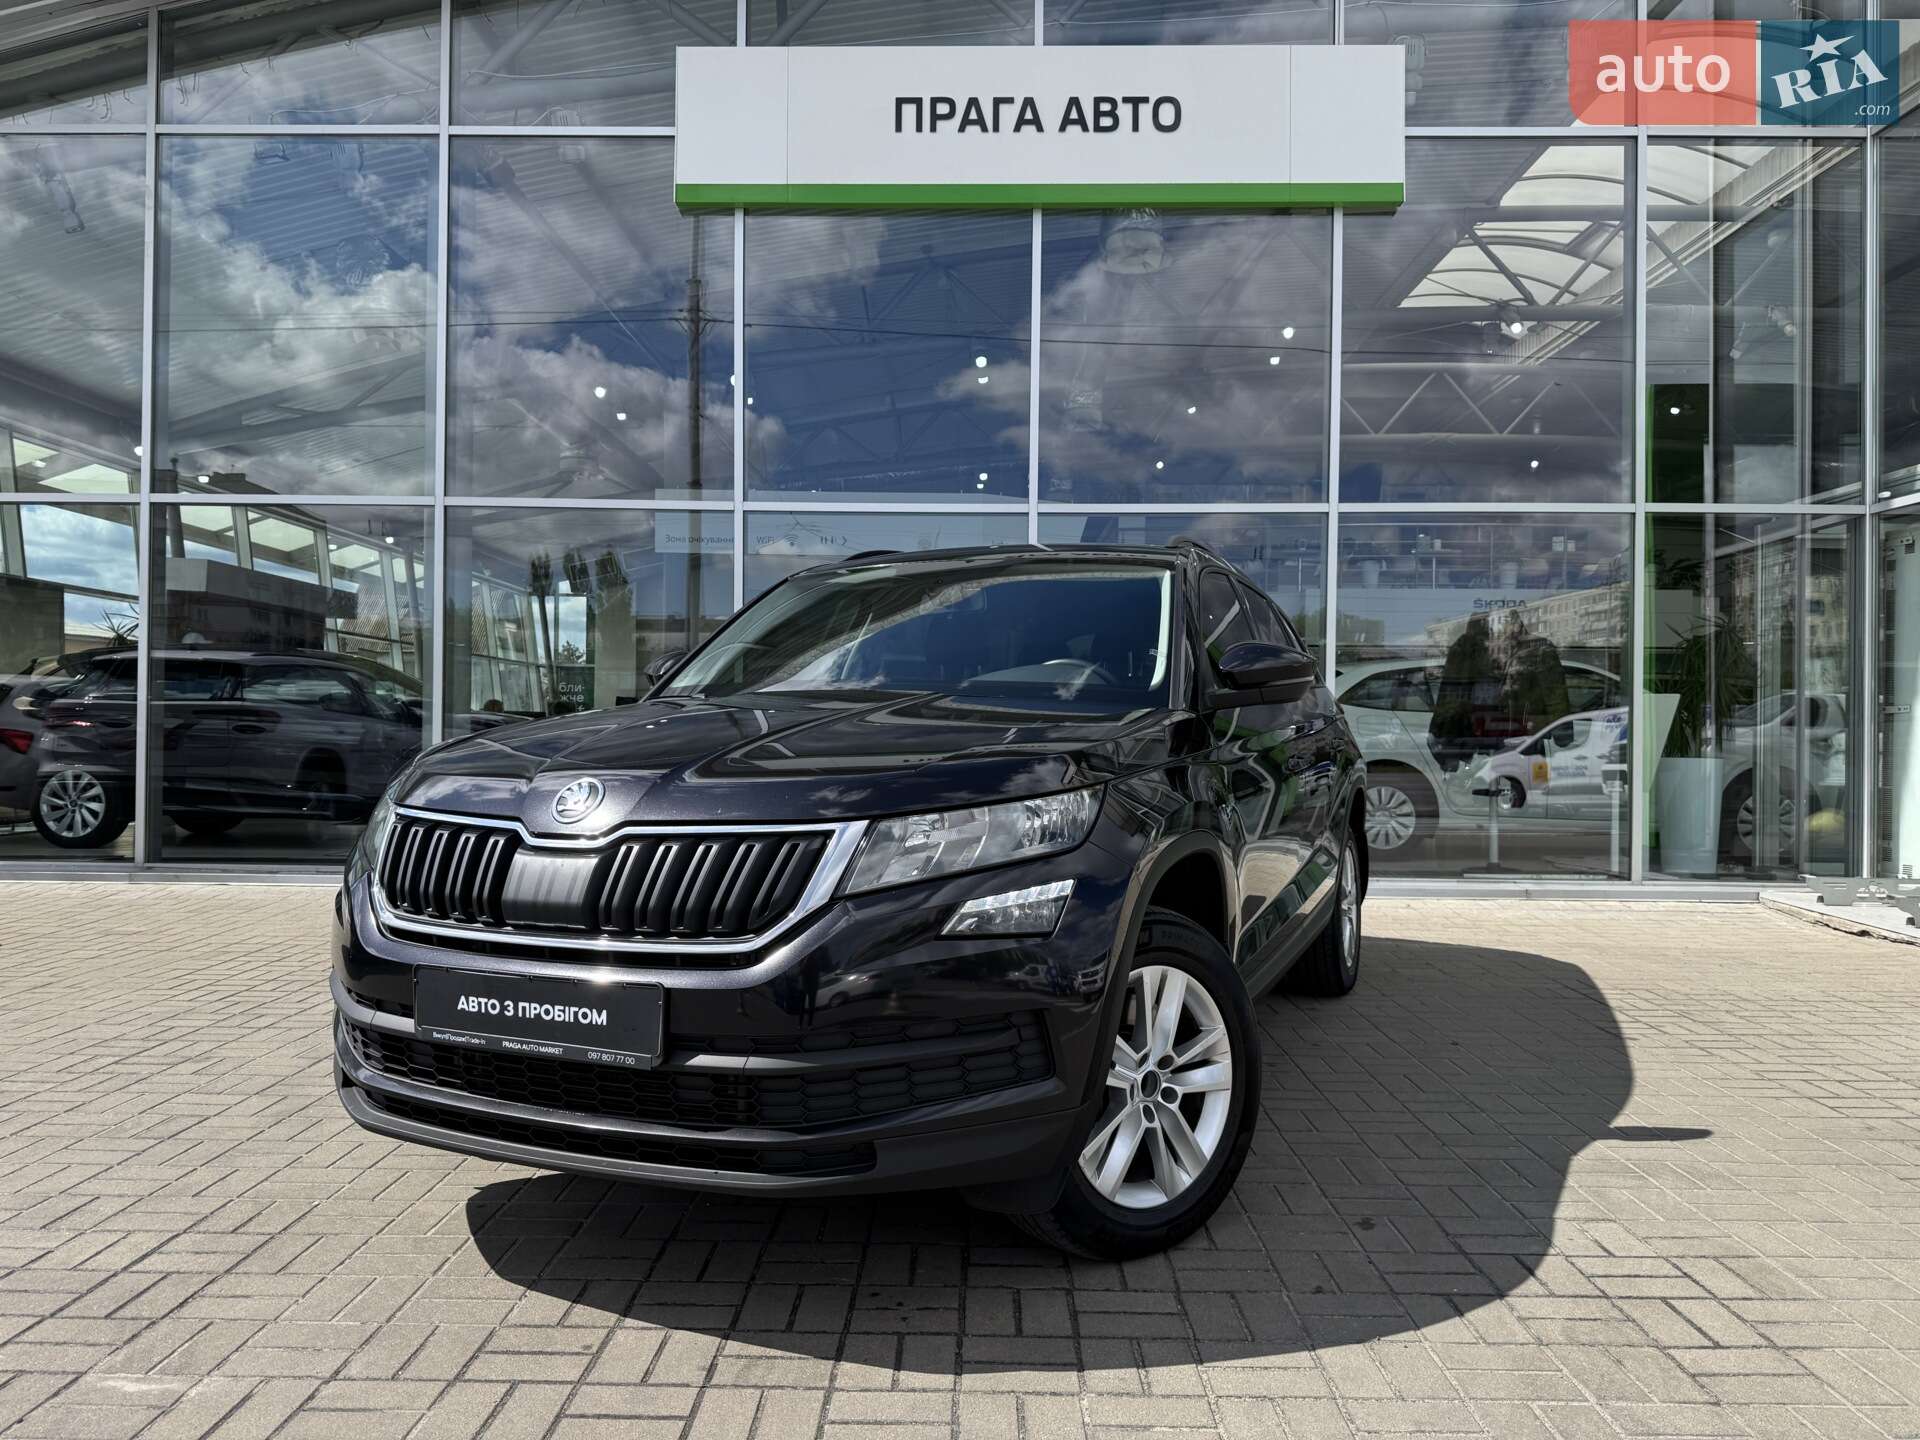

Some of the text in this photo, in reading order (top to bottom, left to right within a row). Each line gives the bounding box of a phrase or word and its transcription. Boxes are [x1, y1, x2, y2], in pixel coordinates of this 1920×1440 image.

[895, 96, 1182, 132] ПРАГА АВТО
[457, 995, 500, 1015] АВТО
[518, 1001, 608, 1026] ПРОБІГОМ
[502, 1040, 563, 1055] PRAGA AUTO MARKET
[587, 1051, 636, 1065] 097 807 77 00
